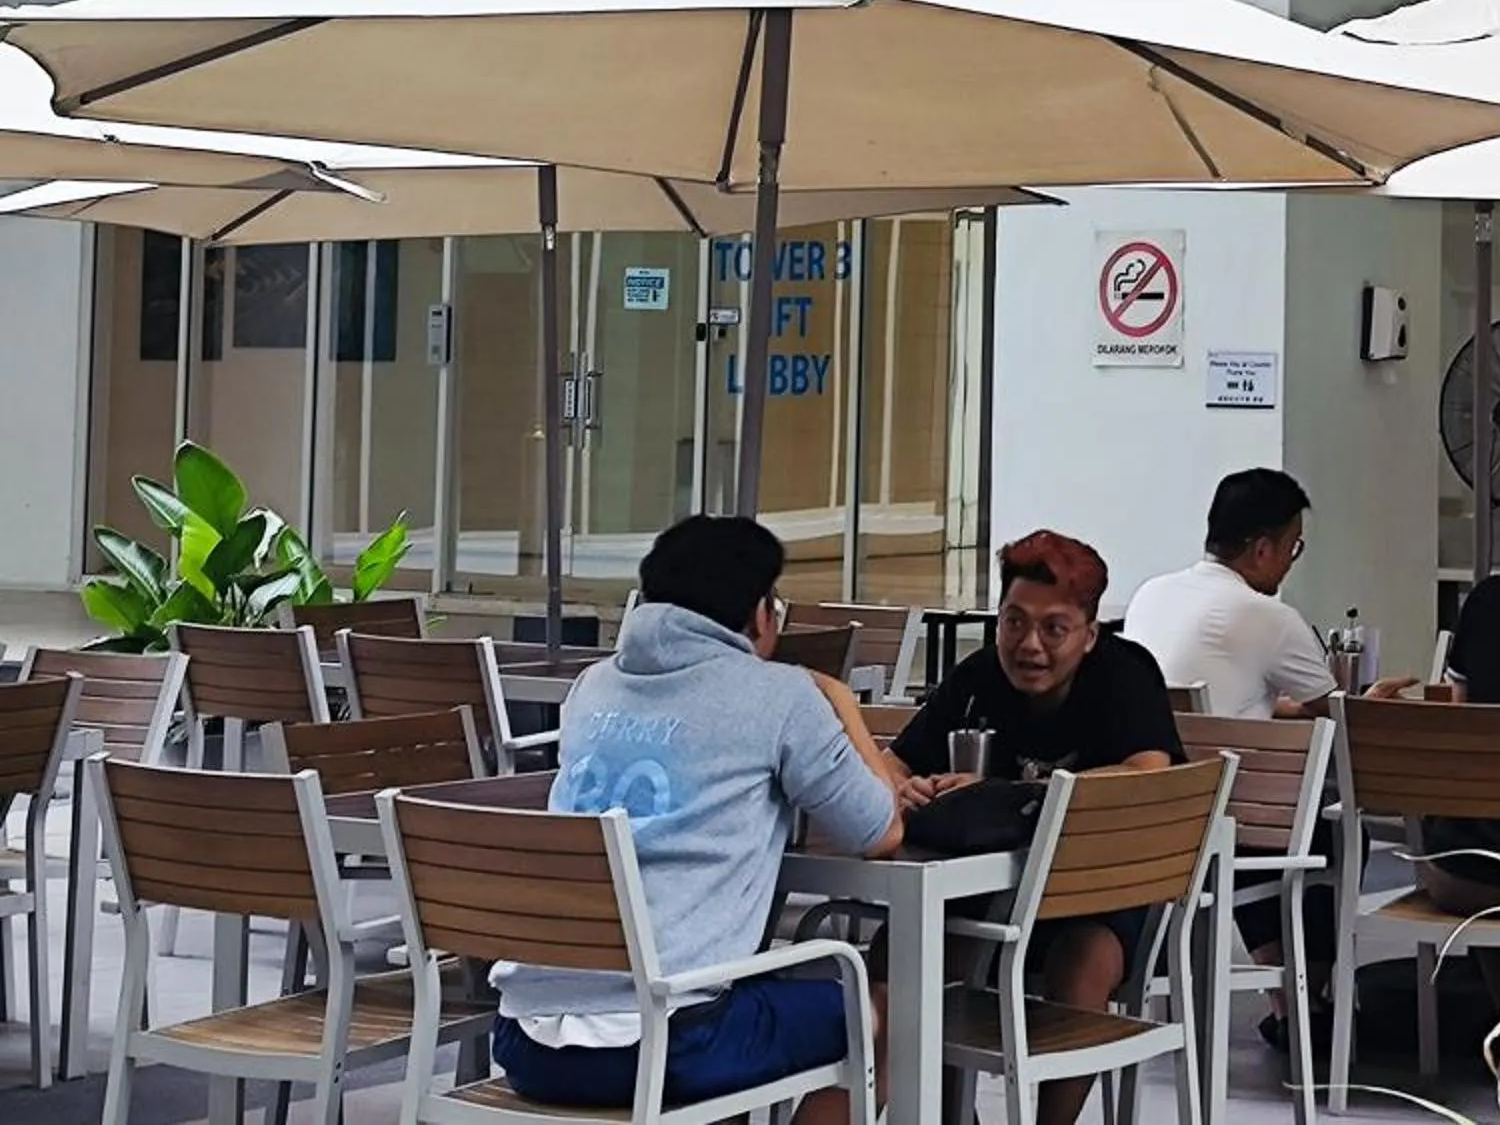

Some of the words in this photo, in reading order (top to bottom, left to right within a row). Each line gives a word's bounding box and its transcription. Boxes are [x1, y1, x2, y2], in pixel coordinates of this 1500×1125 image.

[834, 241, 852, 281] 3
[1097, 344, 1137, 355] DILARANG
[1138, 344, 1178, 356] MEROKOK
[727, 354, 832, 396] LBBY
